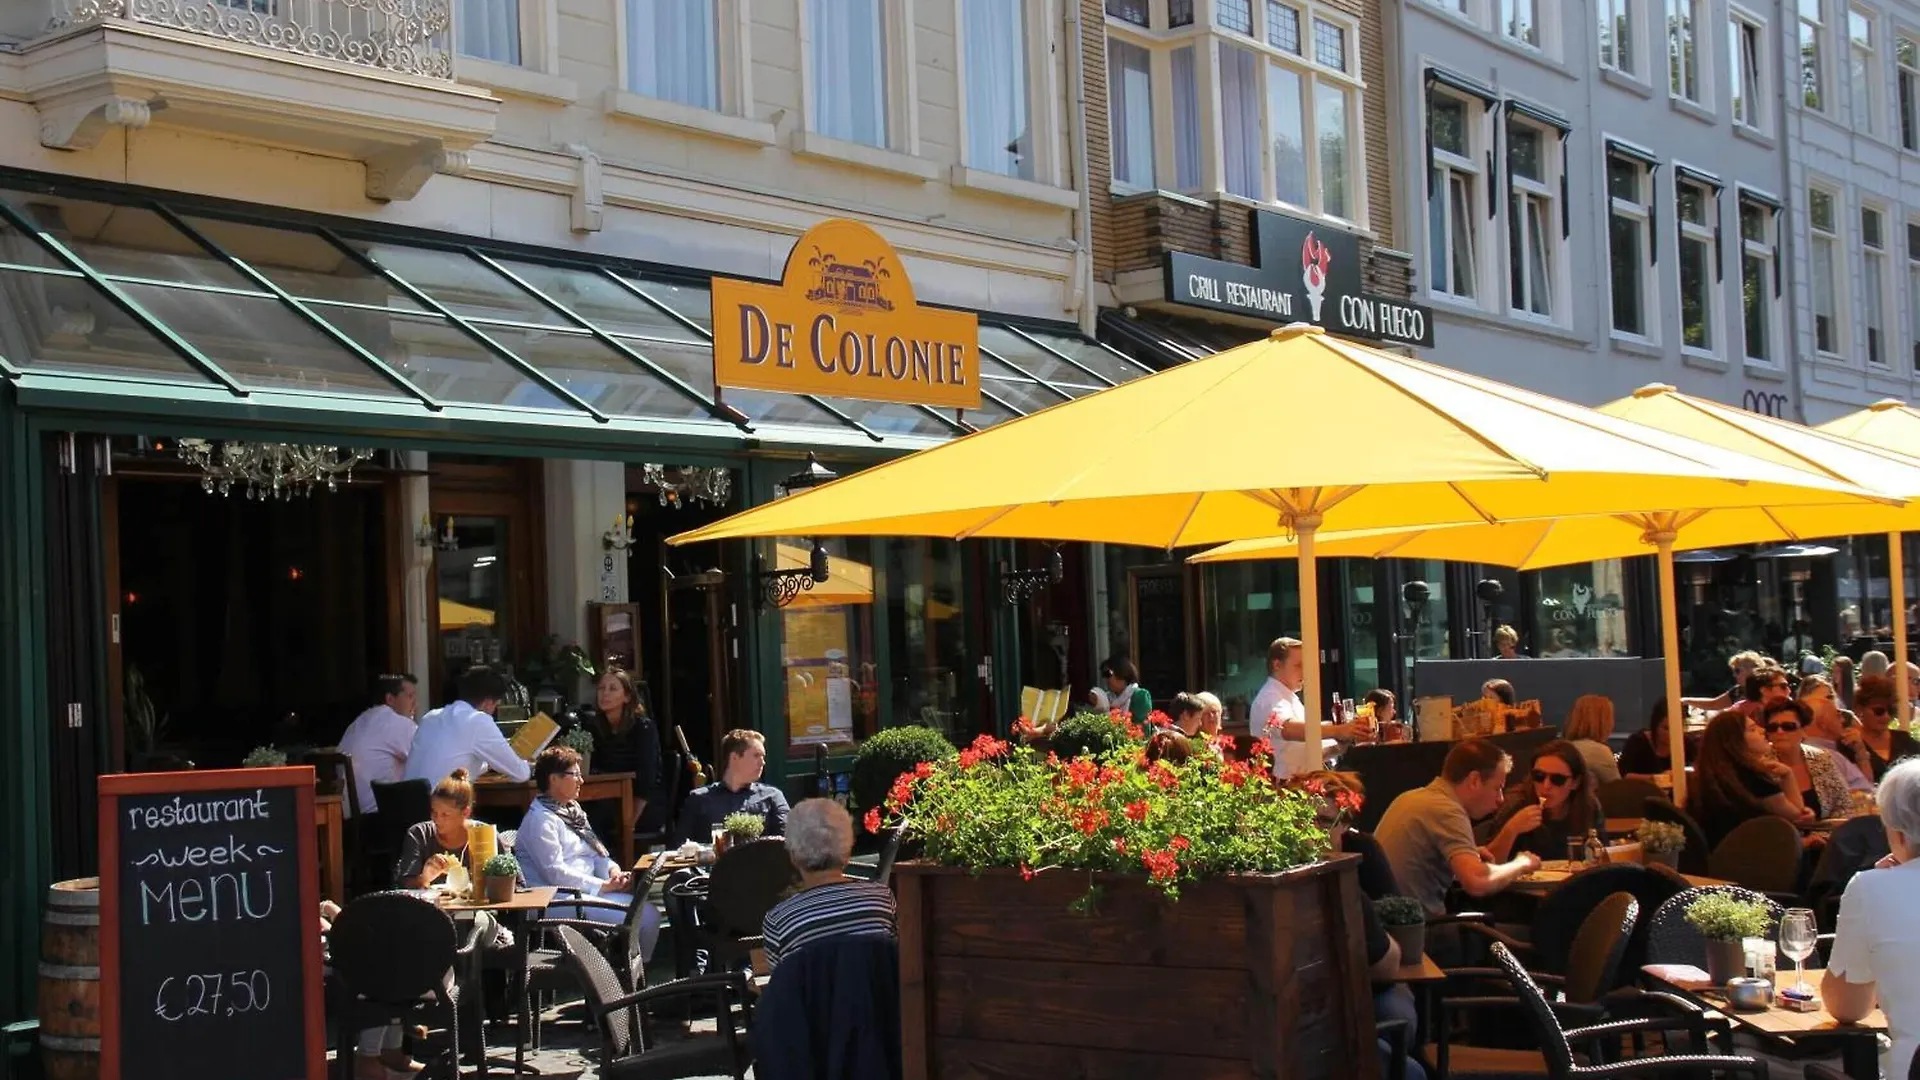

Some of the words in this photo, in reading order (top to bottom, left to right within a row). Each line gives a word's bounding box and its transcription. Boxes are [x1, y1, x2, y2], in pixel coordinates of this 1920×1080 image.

[1188, 274, 1221, 303] GRILL
[1226, 282, 1293, 316] RESTAURANT
[1340, 294, 1375, 333] CON
[1381, 304, 1425, 341] FUEGO
[128, 788, 270, 831] restaurant
[157, 834, 253, 868] week
